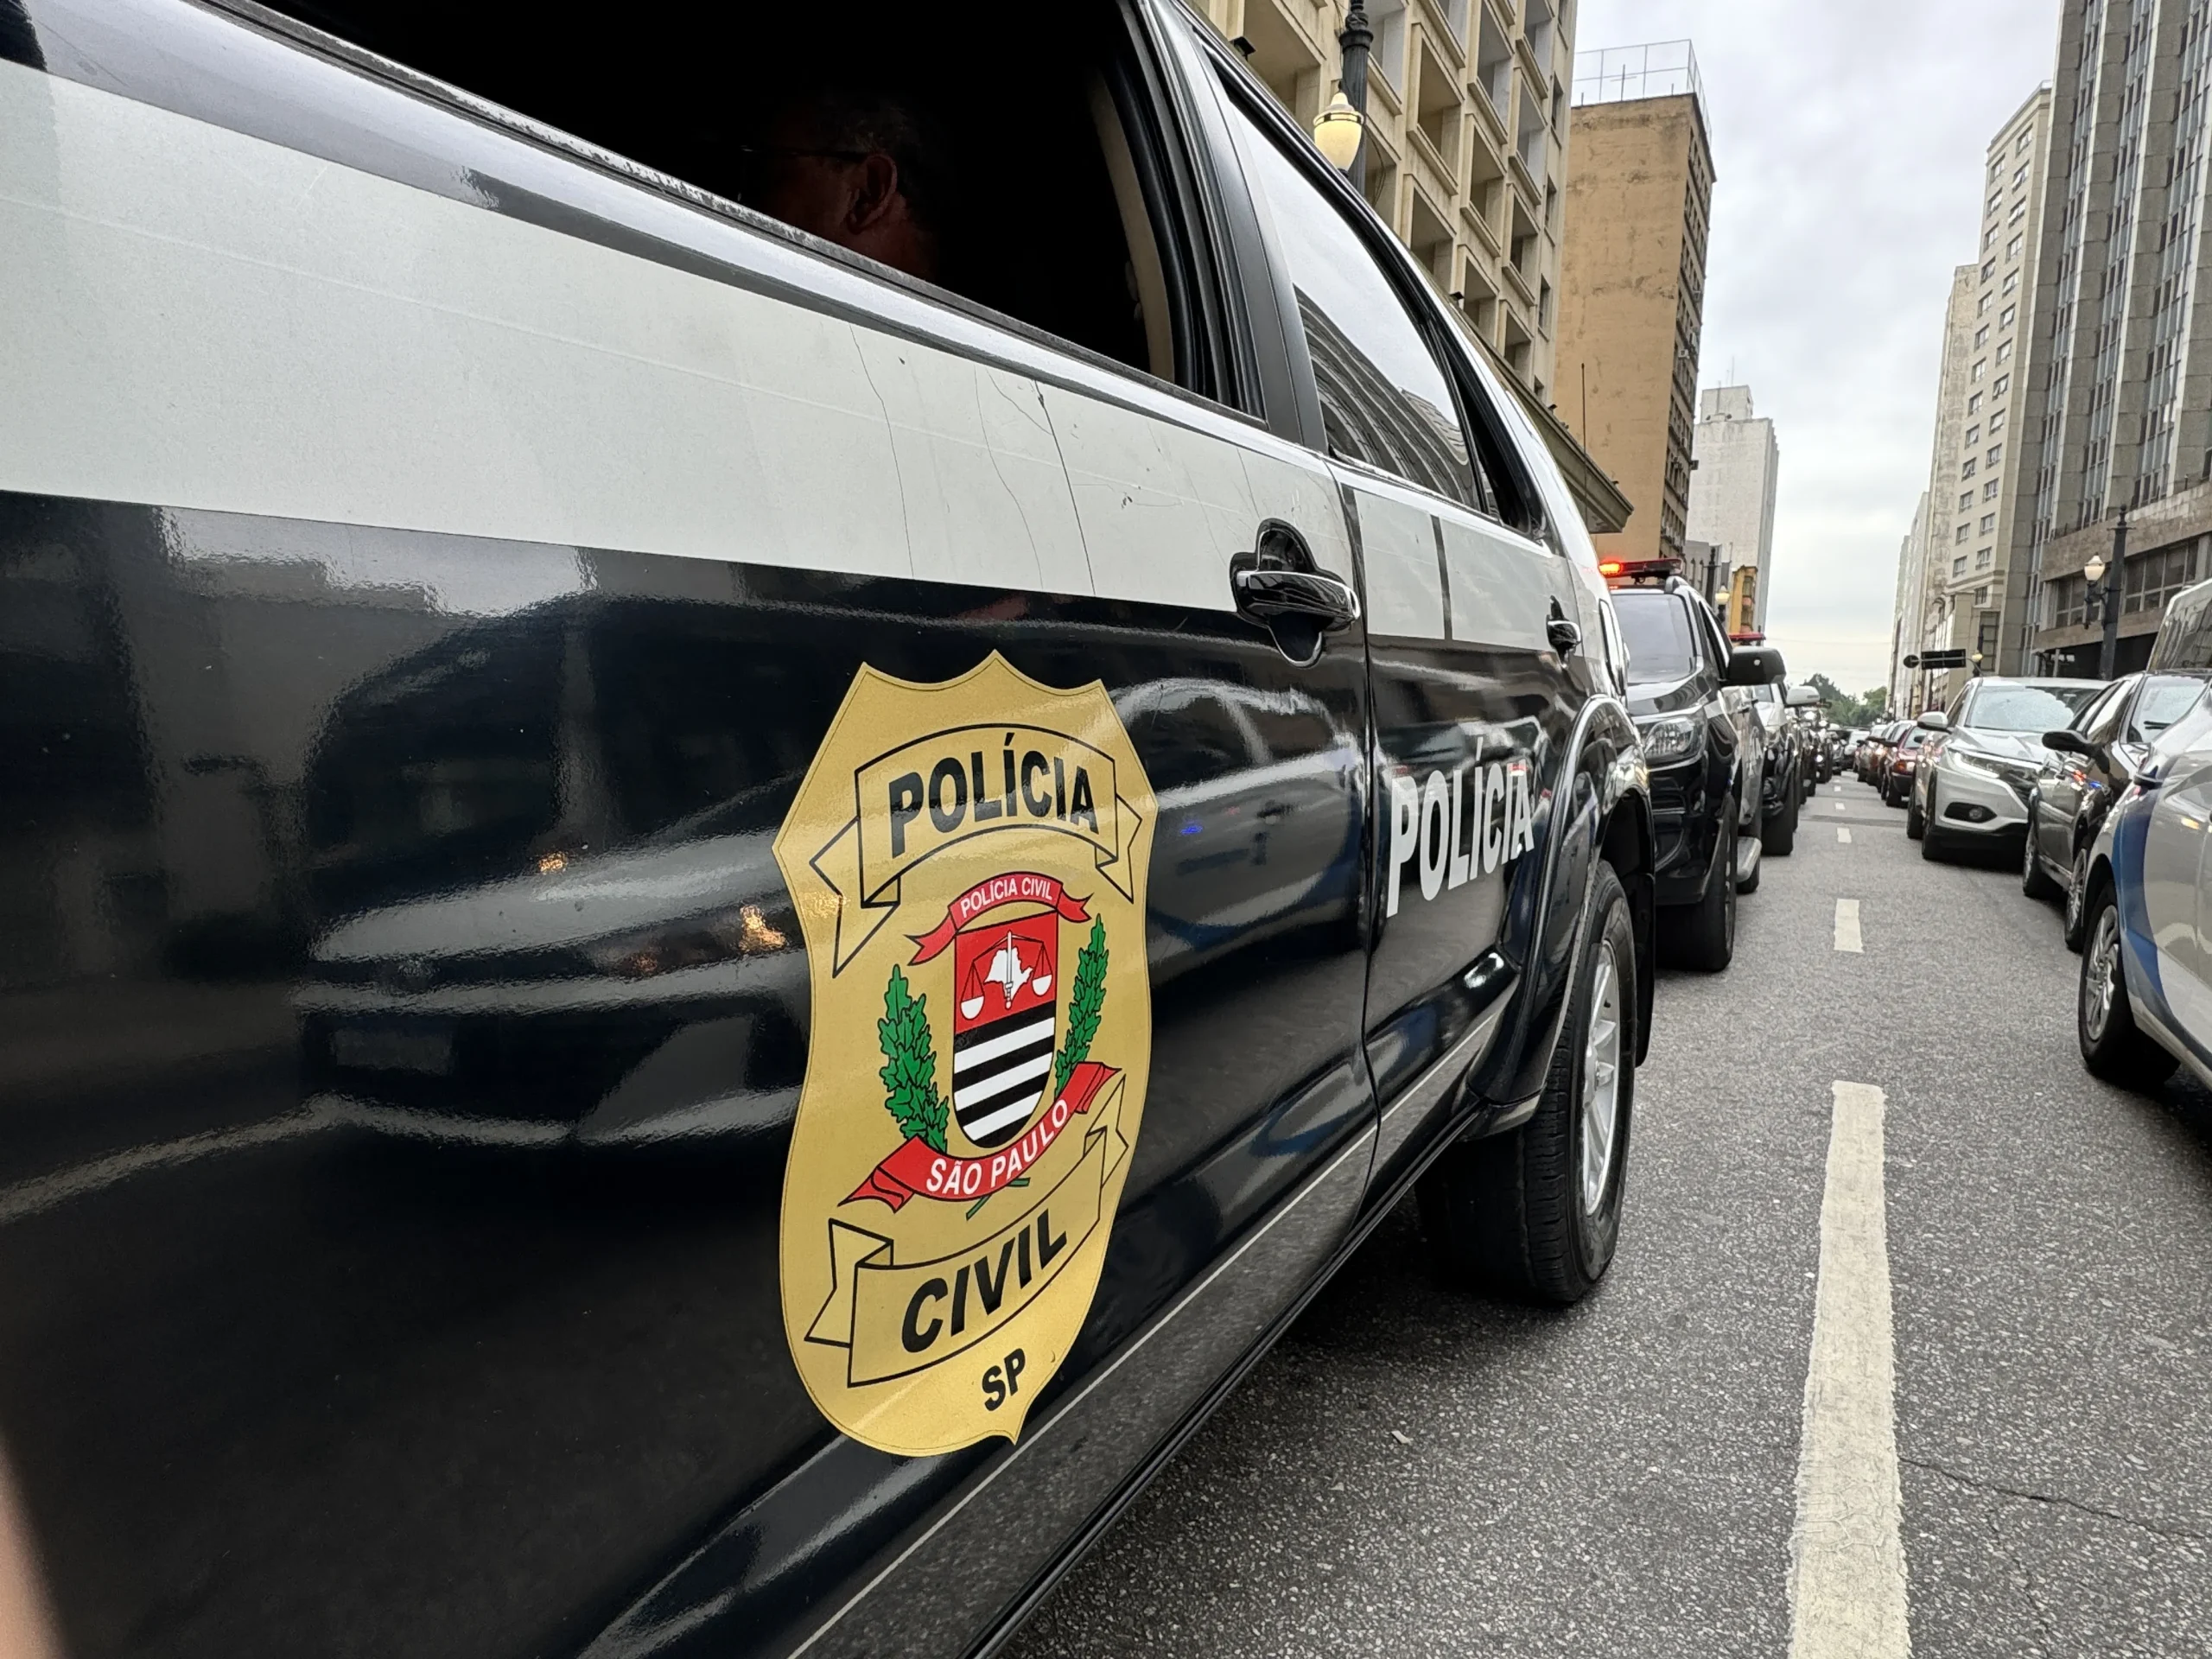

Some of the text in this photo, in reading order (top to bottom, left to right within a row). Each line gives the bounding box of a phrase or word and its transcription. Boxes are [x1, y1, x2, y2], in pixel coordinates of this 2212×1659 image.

[887, 732, 1099, 859] POLÍCIA
[1386, 736, 1535, 918] POLÍCIA
[960, 875, 1053, 918] POLÍCIA CIVIL
[925, 1098, 1069, 1196] SÃO PAULO
[900, 1208, 1068, 1354] CIVIL
[981, 1348, 1027, 1412] SP
